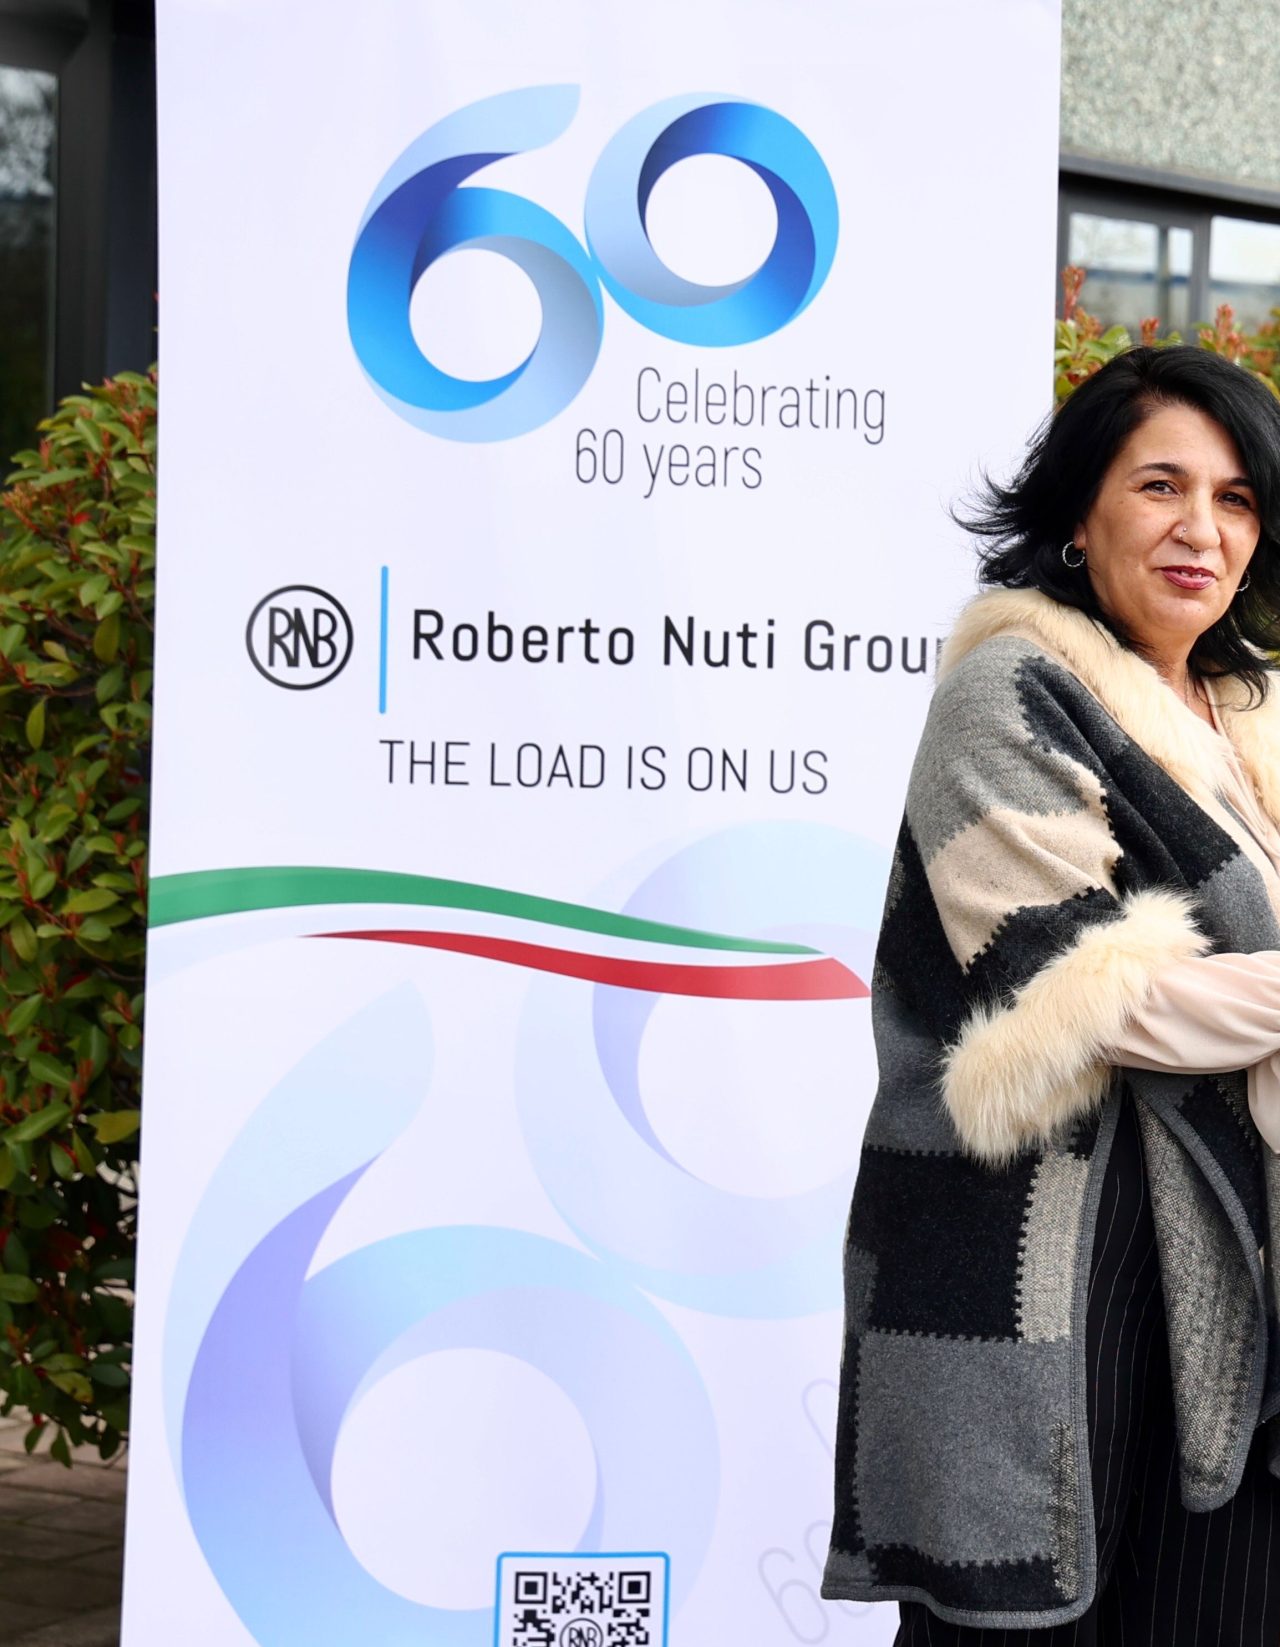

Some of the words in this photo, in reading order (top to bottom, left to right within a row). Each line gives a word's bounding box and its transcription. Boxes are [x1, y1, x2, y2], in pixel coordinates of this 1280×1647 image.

[347, 83, 839, 443] 60
[636, 366, 886, 446] Celebrating
[575, 427, 625, 485] 60
[642, 443, 763, 500] years
[268, 606, 338, 669] RNB
[412, 608, 636, 666] Roberto
[663, 615, 775, 670] Nuti
[804, 619, 943, 675] Grou
[378, 739, 471, 786] THE
[489, 742, 606, 789] LOAD
[627, 745, 667, 791] IS
[687, 746, 748, 792] ON
[769, 749, 828, 795] US
